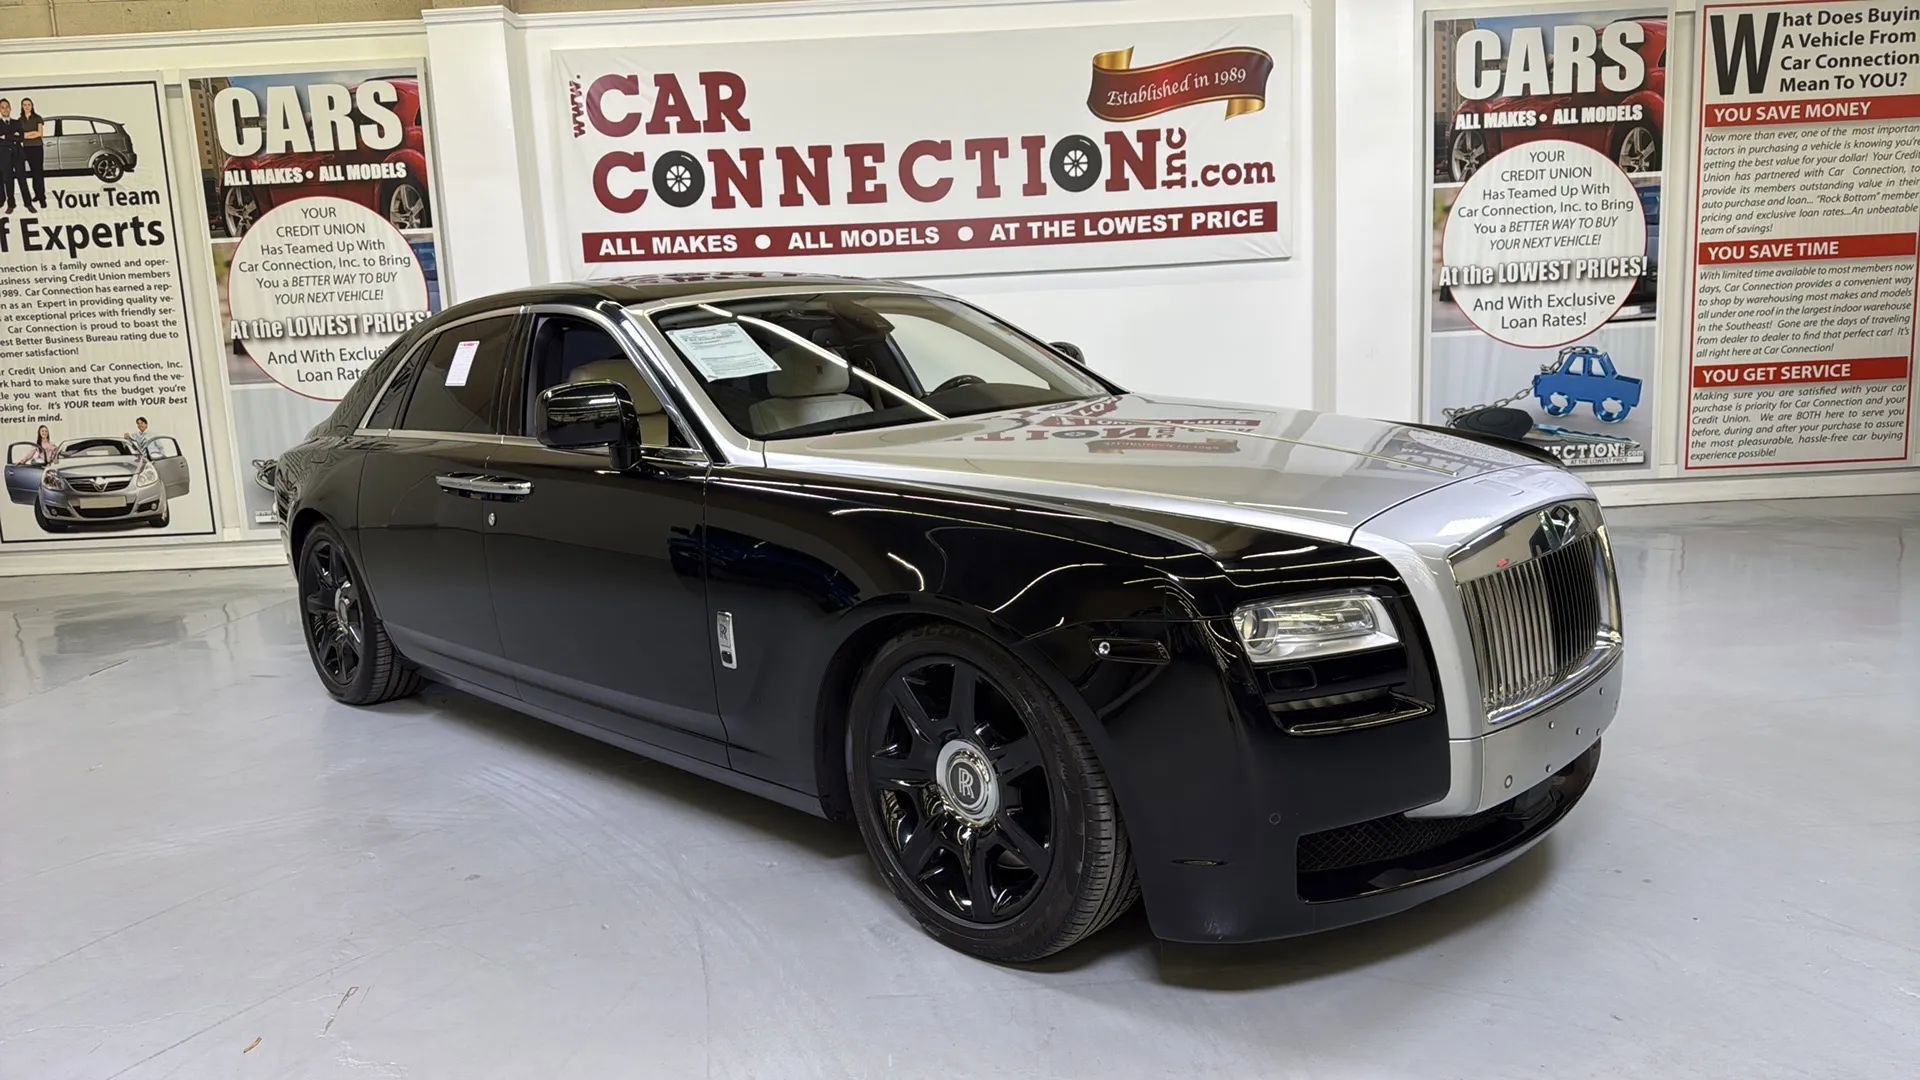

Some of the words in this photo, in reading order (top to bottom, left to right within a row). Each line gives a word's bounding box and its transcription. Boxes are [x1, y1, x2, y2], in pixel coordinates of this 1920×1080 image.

[1818, 11, 1863, 26] Does
[1781, 34, 1794, 49] A
[1799, 30, 1865, 48] Vehicle
[1870, 29, 1916, 45] From
[1456, 21, 1645, 100] CARS
[1781, 56, 1811, 71] Car
[1815, 52, 1920, 69] Connection
[1106, 75, 1190, 107] Established
[1193, 73, 1210, 89] in
[1213, 67, 1247, 86] 1989
[1780, 77, 1830, 93] Mean
[1834, 75, 1855, 90] To
[1859, 72, 1908, 88] YOU?
[586, 71, 751, 138] CAR
[1714, 107, 1752, 123] YOU
[1756, 105, 1801, 121] SAVE
[1805, 101, 1872, 119] MONEY
[214, 80, 403, 157] CARS
[1455, 114, 1481, 130] ALL
[1484, 110, 1537, 129] MAKES
[1552, 108, 1579, 126] ALL
[1581, 105, 1643, 123] MODELS
[1529, 150, 1565, 163] YOUR
[224, 170, 249, 187] ALL
[252, 166, 304, 185] MAKES
[319, 165, 344, 182] ALL
[346, 162, 407, 180] MODELS
[1191, 161, 1276, 188] .com
[1500, 169, 1545, 182] CREDIT
[1550, 167, 1592, 179] UNION
[52, 190, 100, 209] Your
[103, 188, 160, 207] Team
[1482, 188, 1505, 200] Has
[1508, 186, 1557, 200] Teamed
[1561, 186, 1579, 198] Up
[1581, 183, 1610, 195] With
[301, 207, 337, 219] YOUR
[1458, 206, 1479, 218] Car
[1481, 202, 1557, 217] Connection,
[1560, 201, 1582, 213] Inc.
[1585, 201, 1598, 212] to
[1601, 199, 1634, 213] Bring
[276, 225, 320, 238] CREDIT
[323, 223, 366, 235] UNION
[599, 238, 645, 257] ALL
[652, 233, 738, 255] MAKES
[788, 231, 833, 251] ALL
[840, 226, 940, 249] MODELS
[989, 223, 1020, 242] AT
[1027, 220, 1076, 239] THE
[1083, 213, 1184, 237] LOWEST
[1191, 208, 1265, 230] PRICE
[1474, 223, 1497, 235] You
[1499, 225, 1507, 233] a
[1509, 220, 1549, 233] BETTER
[1551, 219, 1577, 230] WAY
[1578, 217, 1593, 229] TO
[1595, 216, 1619, 228] BUY
[1701, 226, 1725, 236] team
[1725, 224, 1737, 235] of
[1736, 223, 1773, 235] savings!
[20, 215, 165, 258] Experts
[1490, 238, 1520, 251] YOUR
[1522, 237, 1552, 249] NEXT
[1553, 234, 1602, 247] VEHICLE!
[260, 243, 284, 255] Has
[286, 241, 334, 255] Teamed
[336, 240, 355, 254] Up
[356, 239, 385, 251] With
[1708, 246, 1745, 261] YOU
[1749, 243, 1793, 259] SAVE
[1796, 241, 1840, 256] TIME
[238, 261, 259, 273] Car
[262, 257, 336, 272] Connection,
[338, 256, 361, 268] Inc.
[362, 256, 376, 267] to
[379, 255, 411, 268] Bring
[1439, 266, 1458, 287] At
[1463, 264, 1494, 285] the
[1498, 260, 1571, 283] LOWEST
[1576, 256, 1648, 279] PRICES!
[1700, 271, 1721, 281] With
[1722, 269, 1753, 280] limited
[1754, 268, 1774, 278] time
[1775, 266, 1817, 277] available
[1817, 267, 1827, 275] to
[1828, 265, 1851, 275] most
[1851, 263, 1893, 273] members
[1894, 263, 1915, 271] now
[256, 277, 280, 289] You
[282, 280, 289, 288] a
[291, 275, 331, 288] BETTER
[333, 274, 357, 286] WAY
[359, 273, 374, 285] TO
[375, 271, 398, 283] BUY
[274, 293, 305, 305] YOUR
[307, 291, 335, 304] NEXT
[337, 289, 384, 302] VEHICLE!
[1473, 298, 1504, 312] And
[1508, 295, 1543, 309] With
[1547, 292, 1616, 307] Exclusive
[7, 326, 23, 335] Car
[25, 323, 77, 333] Connection
[80, 323, 88, 331] is
[90, 321, 118, 332] proud
[120, 321, 131, 329] to
[133, 319, 159, 328] boast
[161, 318, 178, 327] the
[230, 319, 249, 340] At
[252, 318, 284, 339] the
[287, 314, 358, 337] LOWEST
[1501, 316, 1537, 329] Loan
[1542, 312, 1587, 327] Rates!
[25, 347, 79, 357] satisfaction!
[267, 350, 298, 365] And
[300, 348, 336, 363] With
[297, 368, 334, 382] Loan
[1702, 369, 1740, 383] YOU
[1743, 366, 1778, 381] GET
[1780, 363, 1851, 379] SERVICE
[26, 402, 42, 411] for.
[63, 400, 89, 409] YOUR
[117, 398, 138, 407] with
[140, 398, 166, 406] YOUR
[168, 396, 188, 405] best
[27, 414, 36, 422] in
[37, 413, 63, 423] mind.
[1544, 443, 1621, 459] ECTION
[1690, 450, 1737, 461] experience
[1738, 448, 1777, 459] possible!
